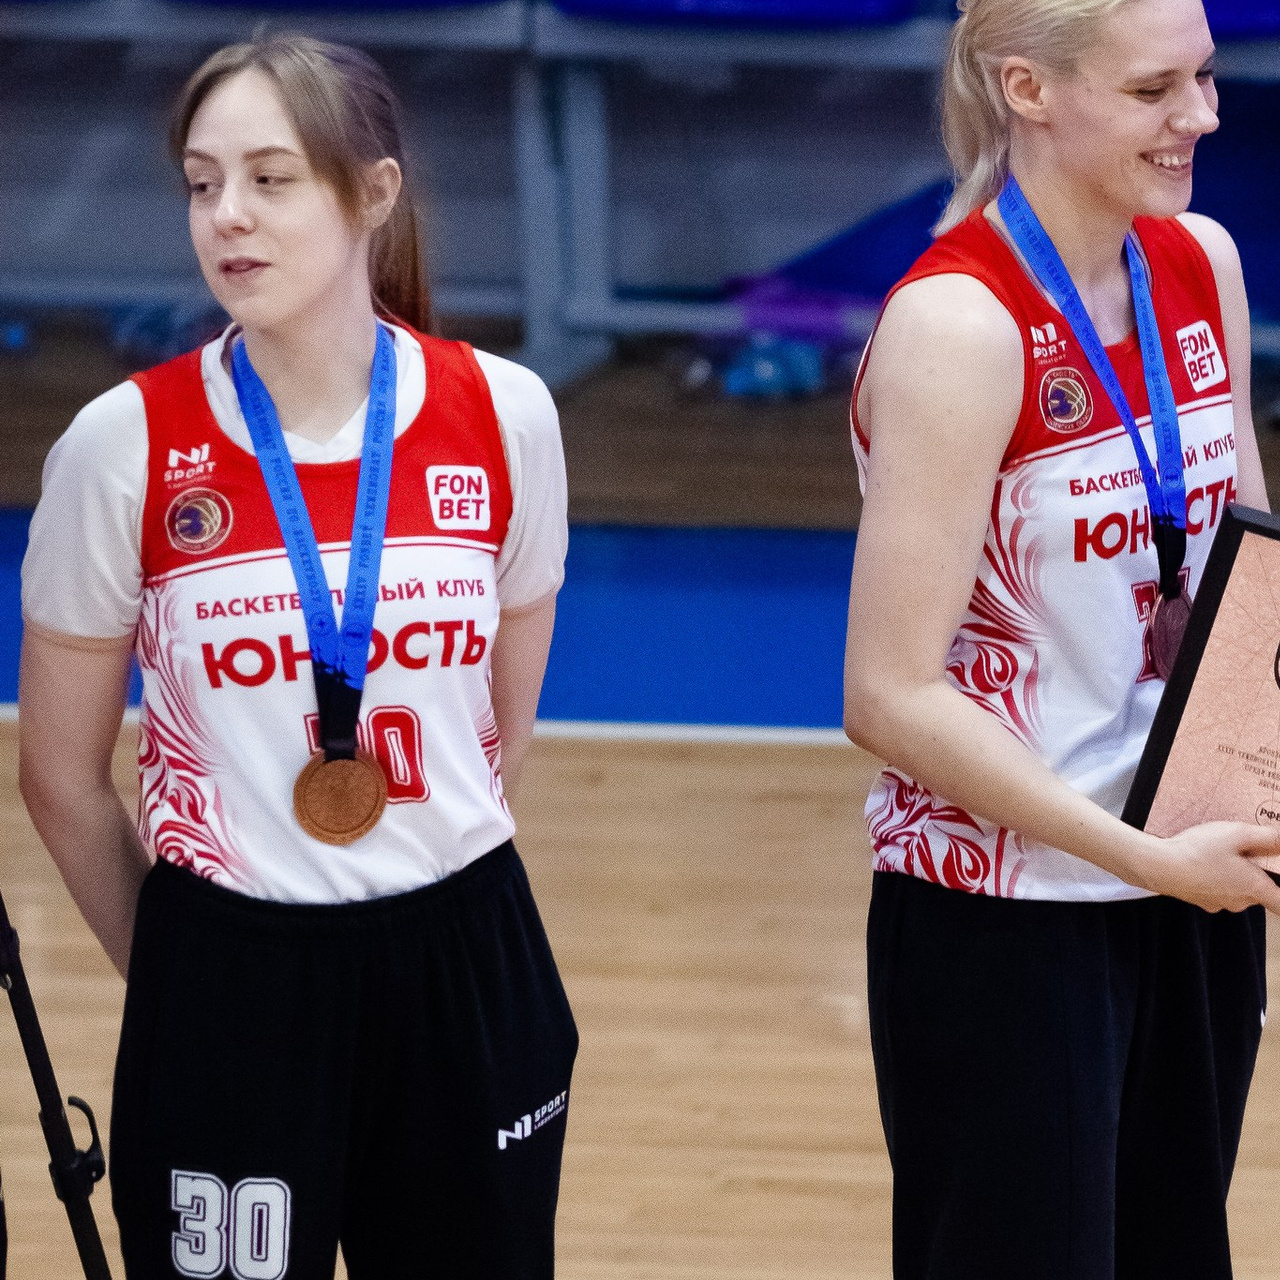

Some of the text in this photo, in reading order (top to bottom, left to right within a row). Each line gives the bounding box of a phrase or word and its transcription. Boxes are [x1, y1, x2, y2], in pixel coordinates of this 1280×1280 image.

[1033, 340, 1067, 359] SPORT
[1180, 328, 1210, 360] FON
[1189, 351, 1216, 384] BET
[1203, 433, 1236, 462] КЛУБ
[434, 475, 482, 495] FON
[438, 499, 485, 520] BET
[1074, 475, 1237, 562] ЮНСТЬ
[196, 577, 485, 620] БАСКЕТБЛЫЙ КЛУБ
[534, 1090, 567, 1122] SPORT
